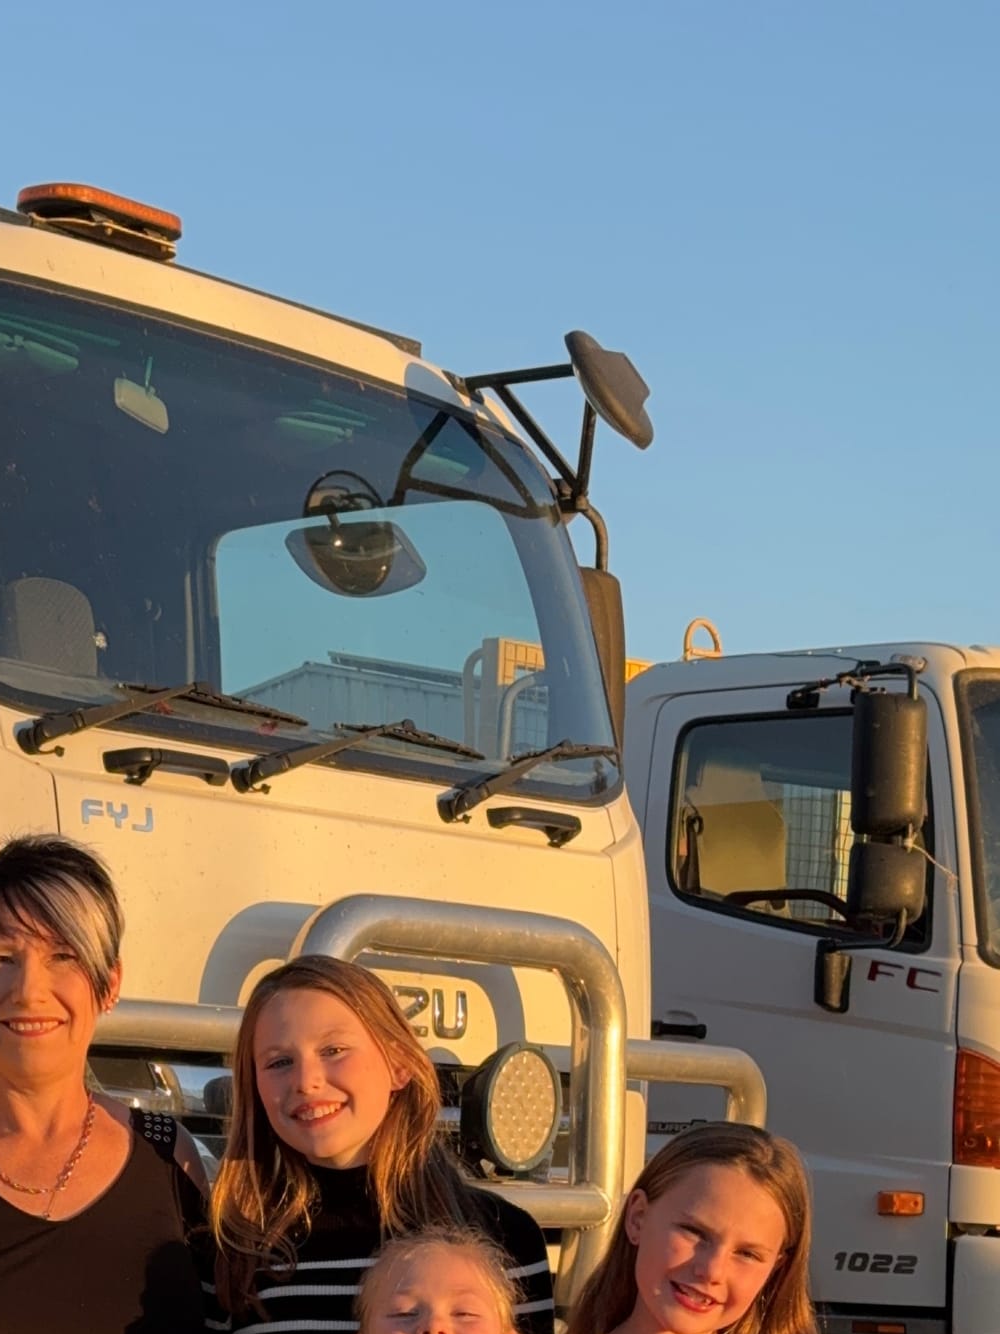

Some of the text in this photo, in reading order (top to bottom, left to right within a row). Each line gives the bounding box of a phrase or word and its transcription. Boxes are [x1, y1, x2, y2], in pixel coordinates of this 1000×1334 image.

[81, 799, 154, 833] FYJ
[867, 960, 942, 993] FC
[834, 1251, 919, 1275] 1022
